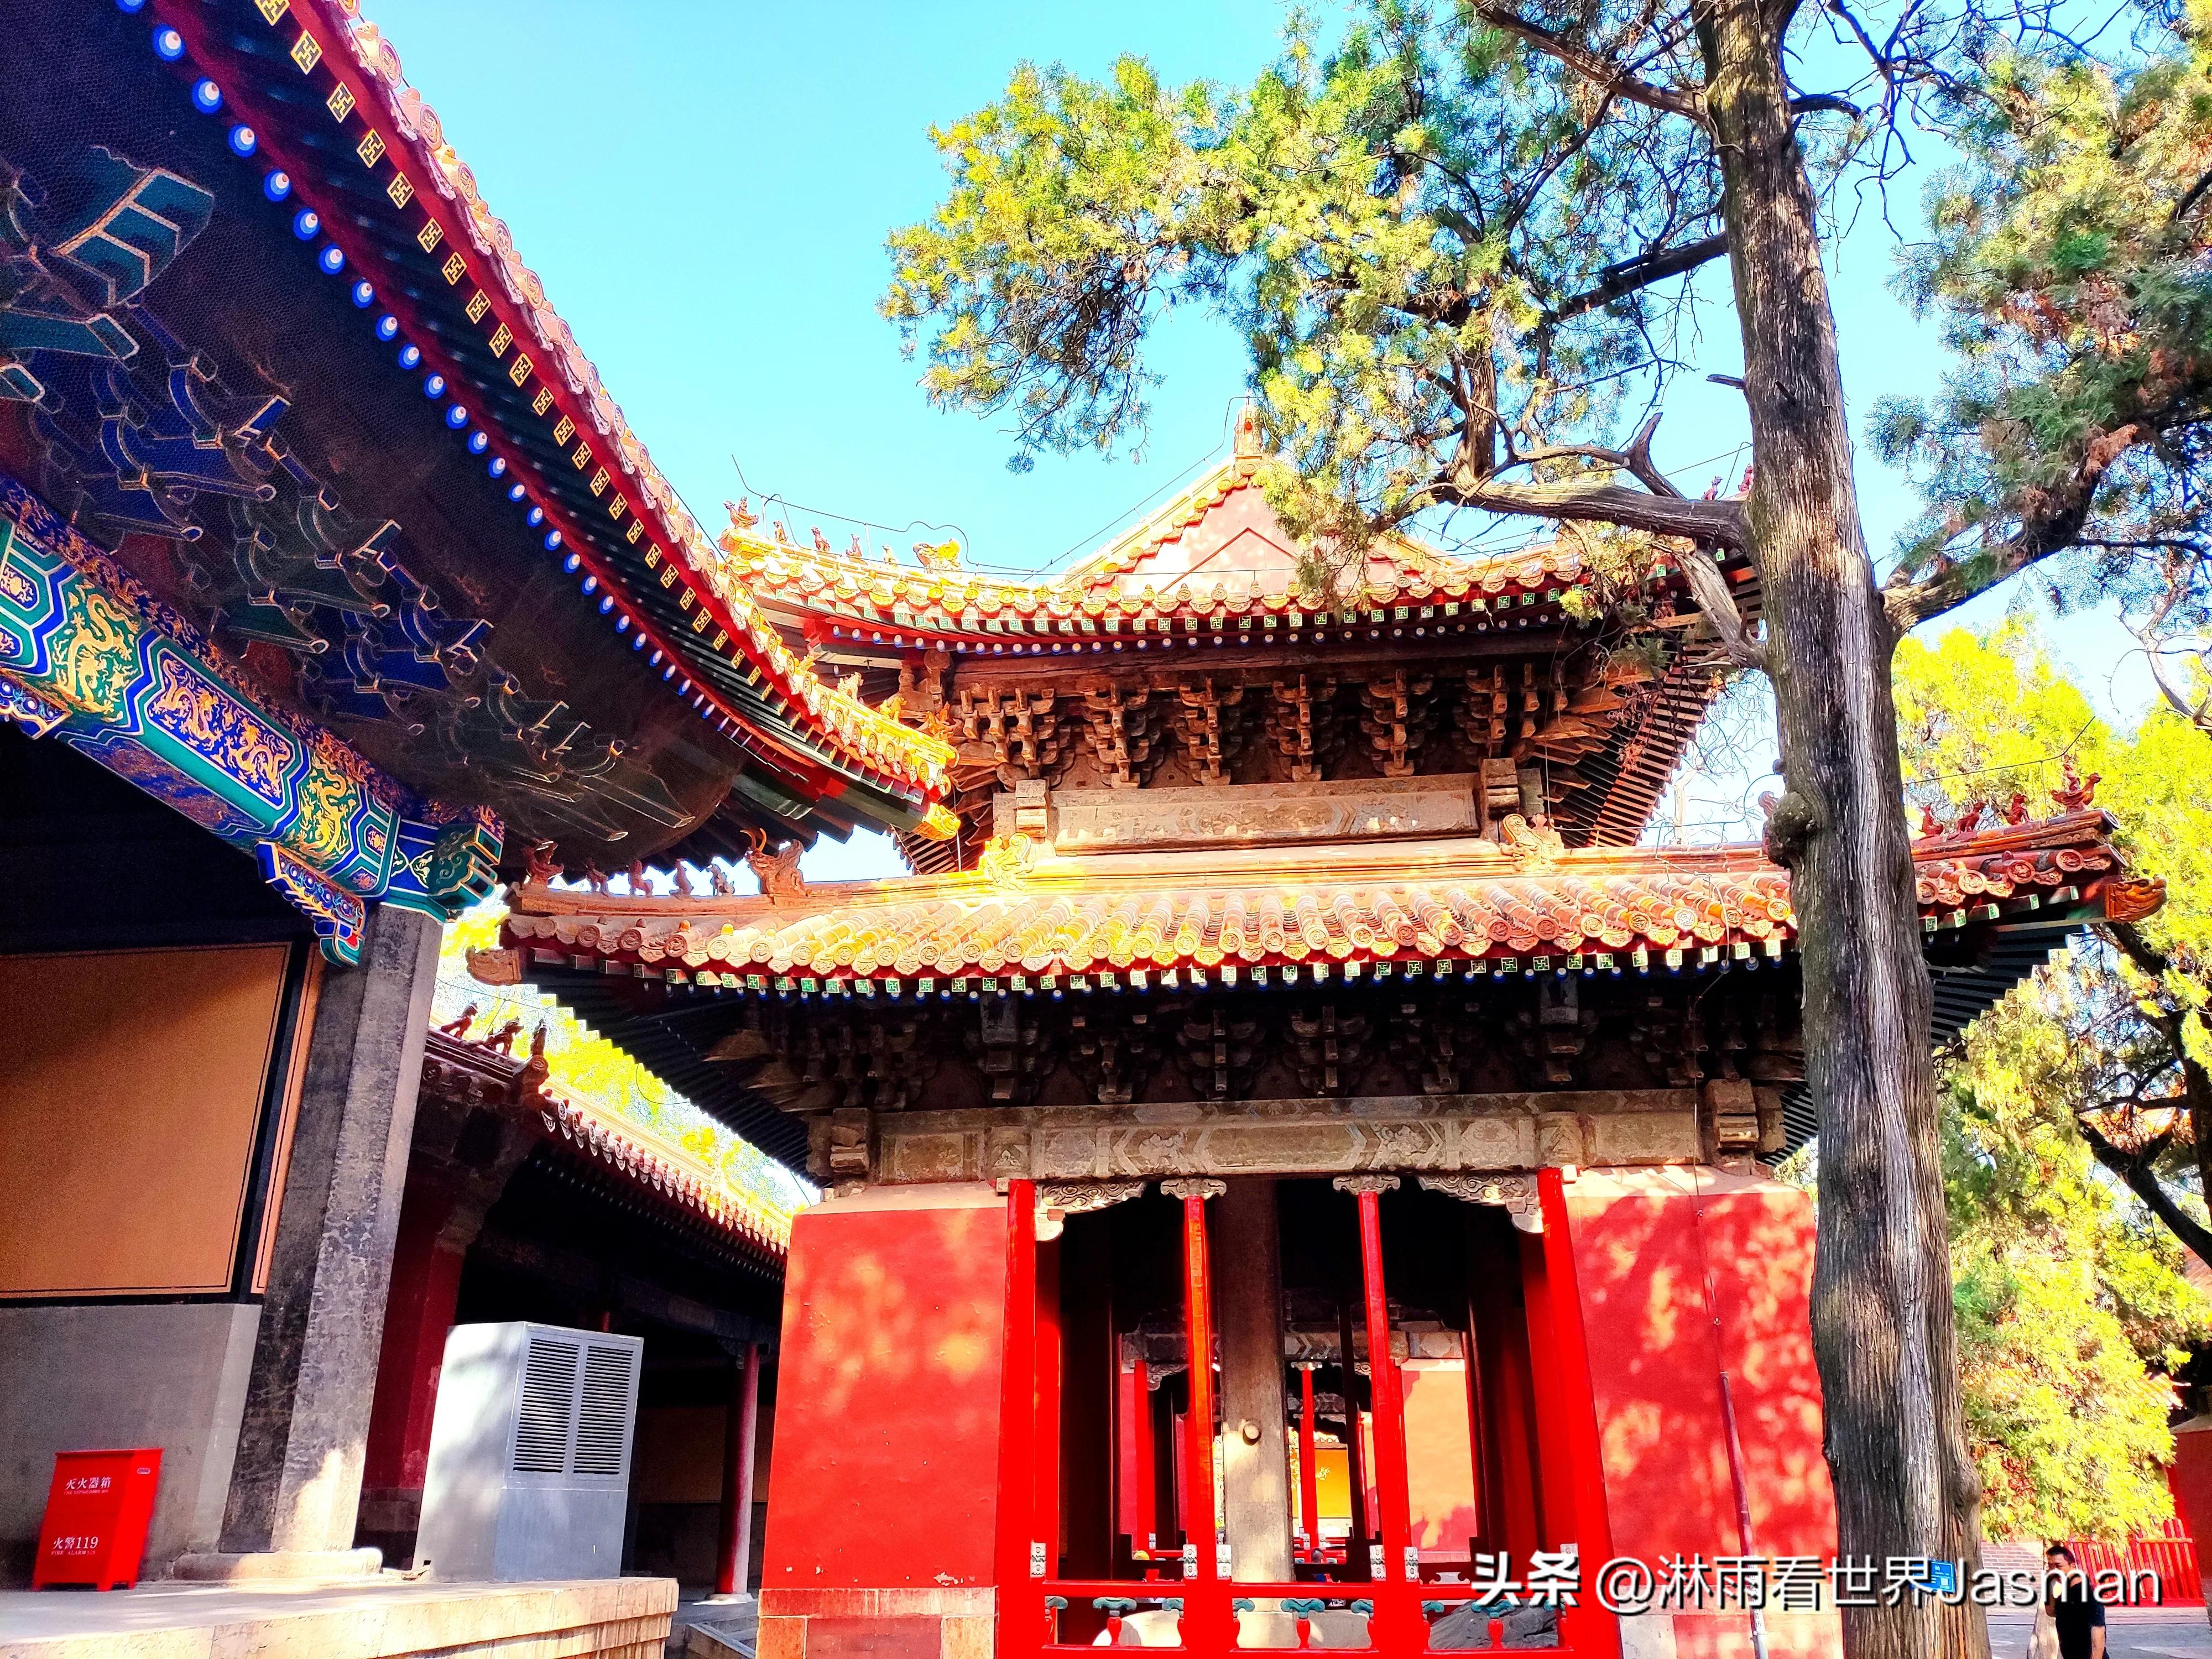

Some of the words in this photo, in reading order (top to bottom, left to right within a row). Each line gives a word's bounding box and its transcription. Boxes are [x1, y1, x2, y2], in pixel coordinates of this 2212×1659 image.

[65, 1477, 112, 1490] 灭火器箱
[53, 1536, 98, 1550] 火警119
